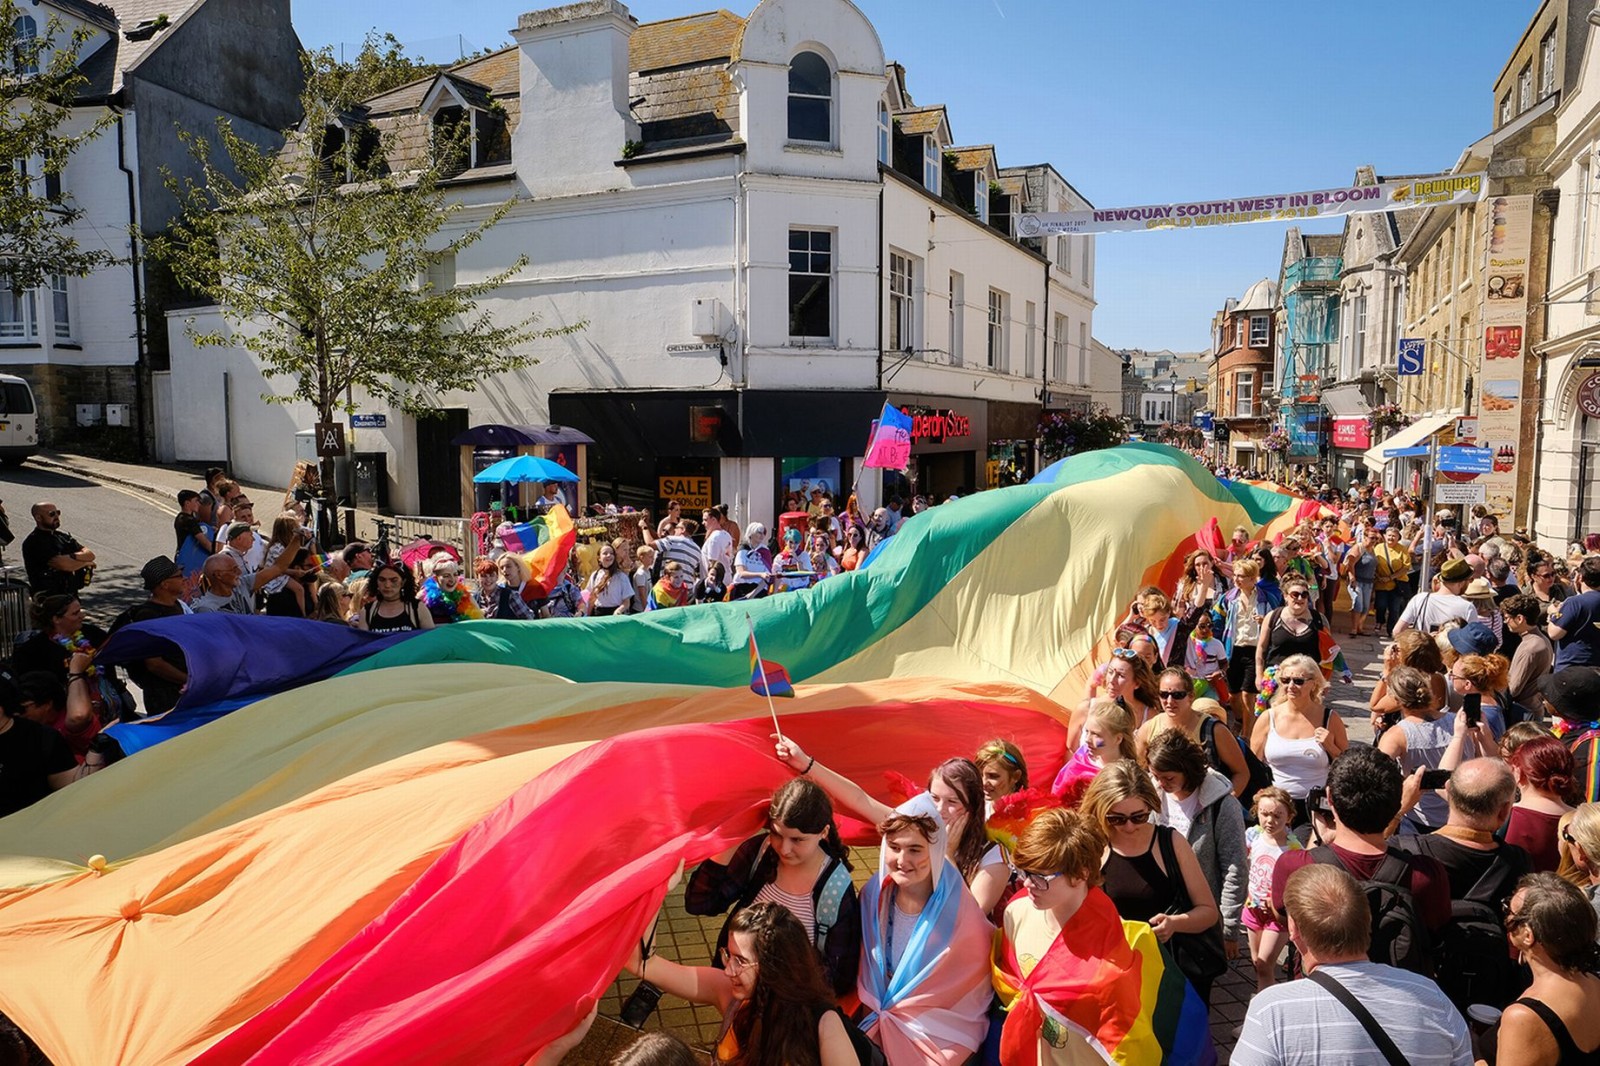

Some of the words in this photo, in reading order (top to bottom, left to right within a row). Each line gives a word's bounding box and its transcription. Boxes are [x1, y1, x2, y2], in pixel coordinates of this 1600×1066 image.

[1415, 175, 1481, 200] newquay
[1093, 206, 1172, 222] NEWQUAY
[1176, 200, 1235, 217] SOUTH
[1239, 198, 1286, 212] WEST
[1289, 194, 1308, 207] IN
[1312, 186, 1381, 206] BLOOM
[1145, 217, 1192, 230] GOLD
[1194, 210, 1272, 226] WINNERS
[1275, 206, 1319, 220] 2018
[667, 344, 703, 352] CHELTENHAM
[663, 479, 708, 496] SALE
